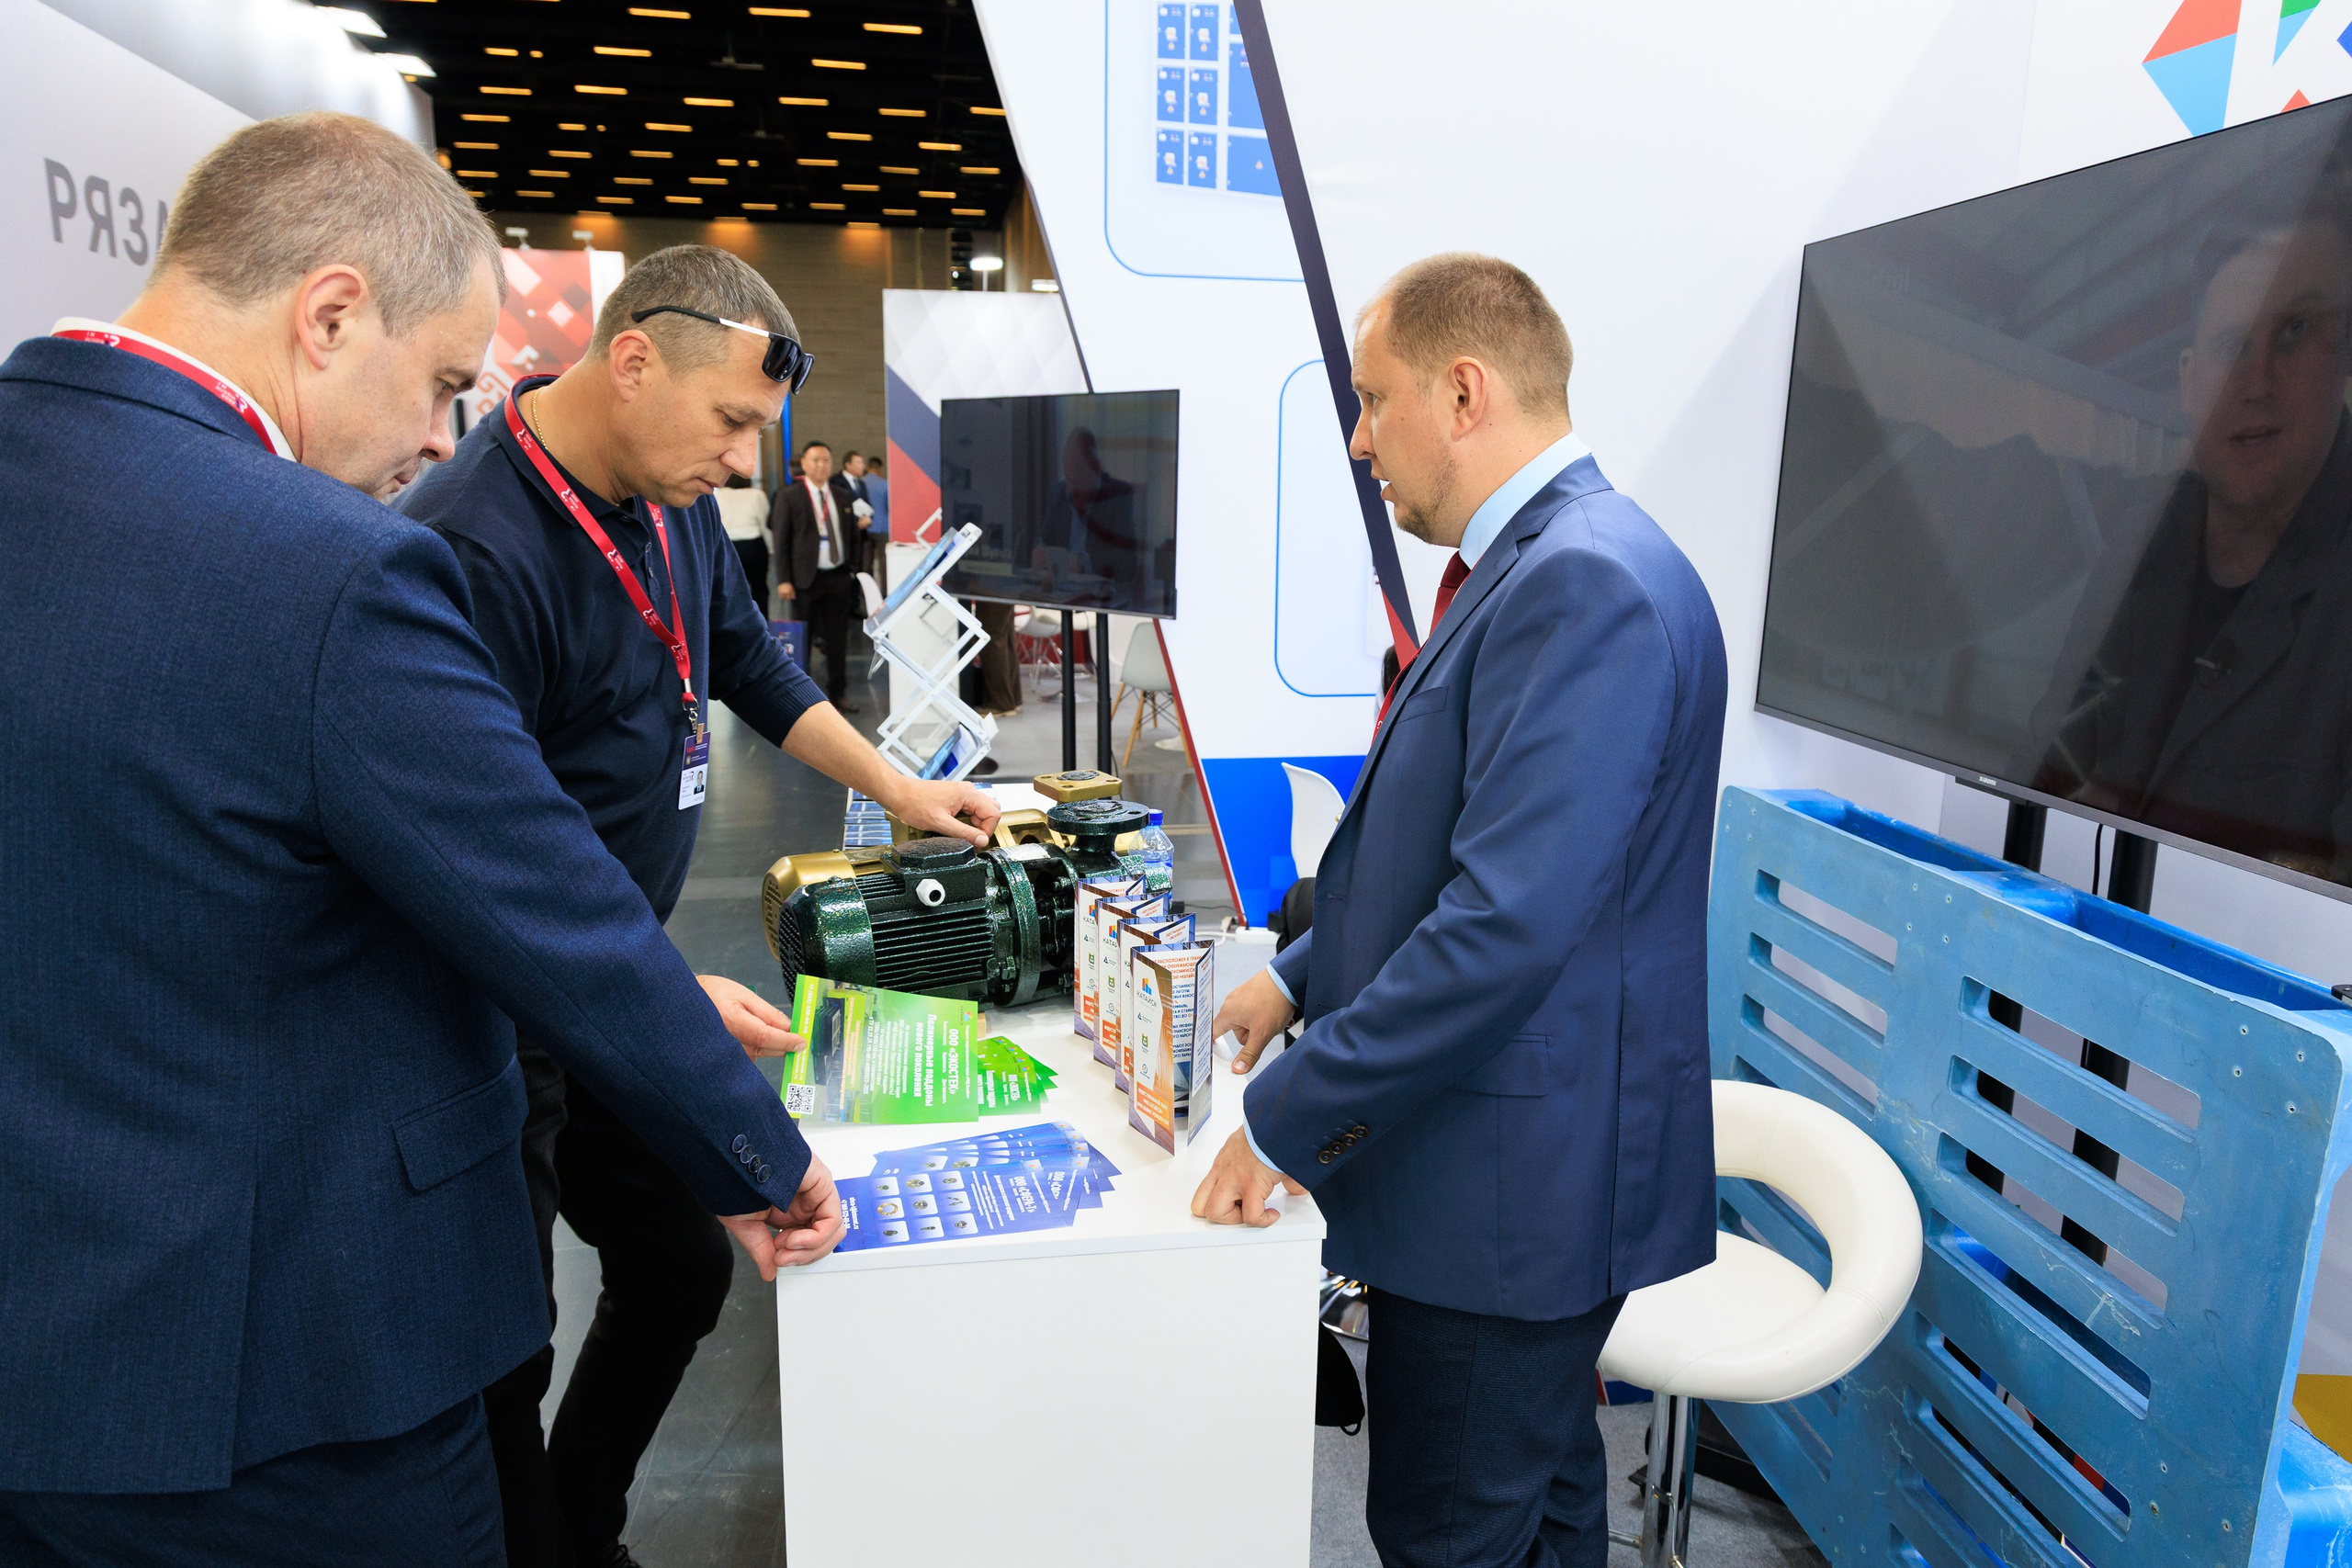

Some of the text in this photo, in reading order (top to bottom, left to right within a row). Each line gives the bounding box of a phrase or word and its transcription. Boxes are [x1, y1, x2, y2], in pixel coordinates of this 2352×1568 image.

[1136, 990, 1158, 1008] КАТАЙСК
[913, 1022, 923, 1097] нового поколения
[924, 1014, 937, 1107] Полимерные поддоны
[948, 1029, 958, 1095] ООО «ЭКОСТЕК»
[1013, 1176, 1027, 1187] ООО
